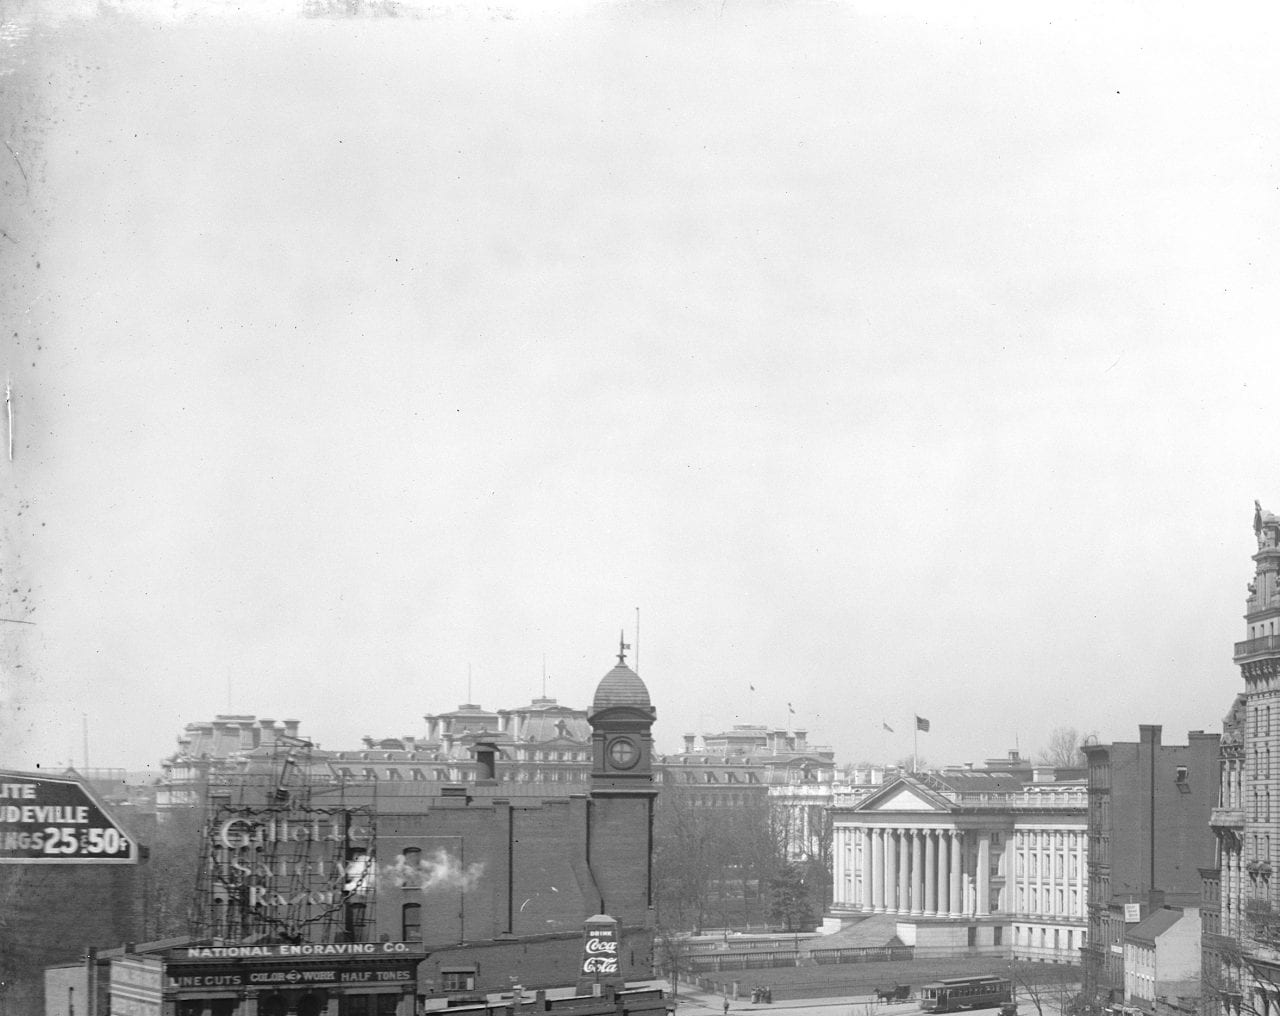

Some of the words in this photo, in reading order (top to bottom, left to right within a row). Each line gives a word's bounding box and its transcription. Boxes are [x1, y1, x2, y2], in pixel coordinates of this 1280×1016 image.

[44, 827, 79, 854] 25
[188, 946, 273, 958] NATIONAL
[280, 943, 376, 955] ENGRAVING
[383, 941, 410, 953] CO.
[586, 938, 618, 954] Coca
[583, 957, 618, 973] Cola
[170, 976, 203, 987] LINE
[205, 975, 242, 986] CUTS
[250, 972, 286, 983] COLOR
[302, 971, 336, 982] WORK
[341, 972, 372, 982] HALF
[376, 970, 411, 981] TONES
